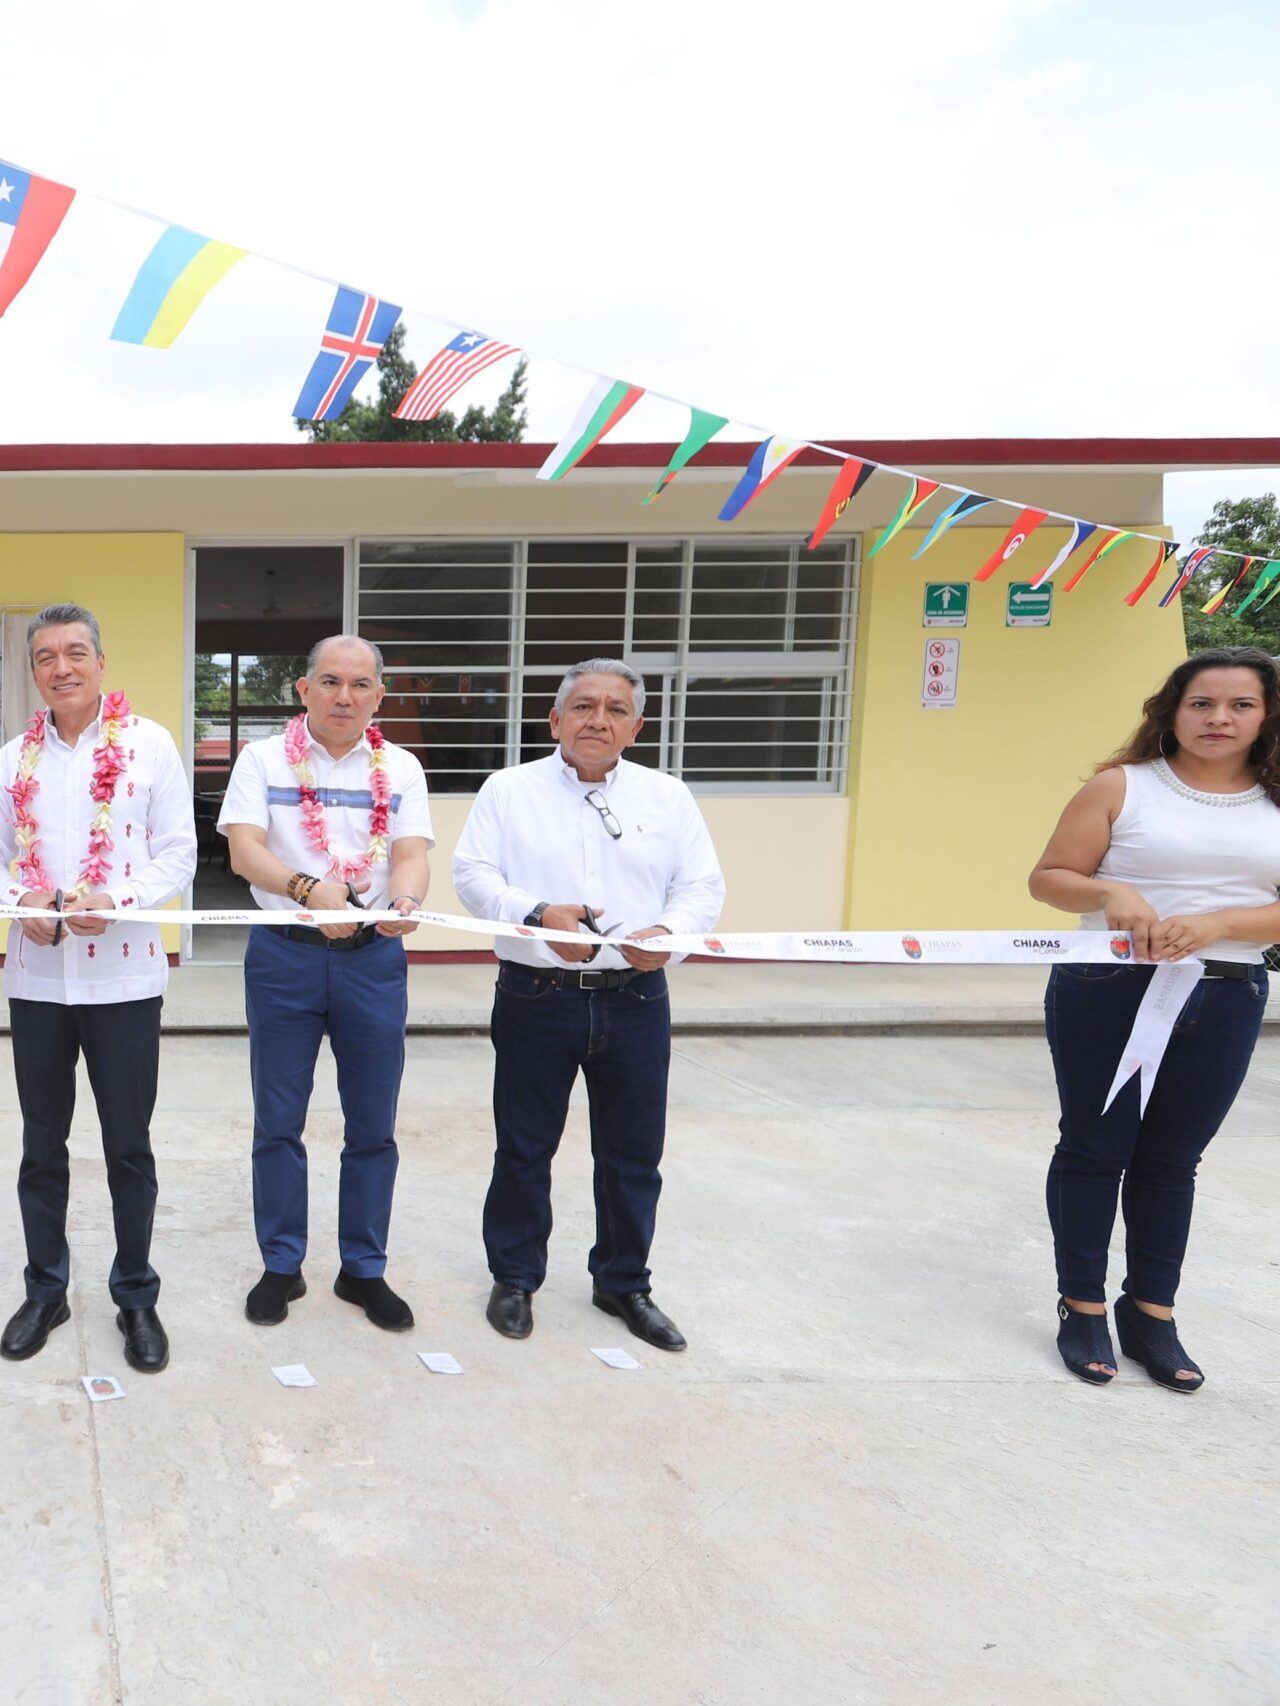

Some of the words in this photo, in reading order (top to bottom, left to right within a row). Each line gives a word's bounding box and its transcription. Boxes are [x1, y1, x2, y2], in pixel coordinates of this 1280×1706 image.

[804, 939, 853, 947] CHIAPAS
[923, 940, 962, 949] CHIAPAS
[1013, 939, 1060, 948] CHIAPAS
